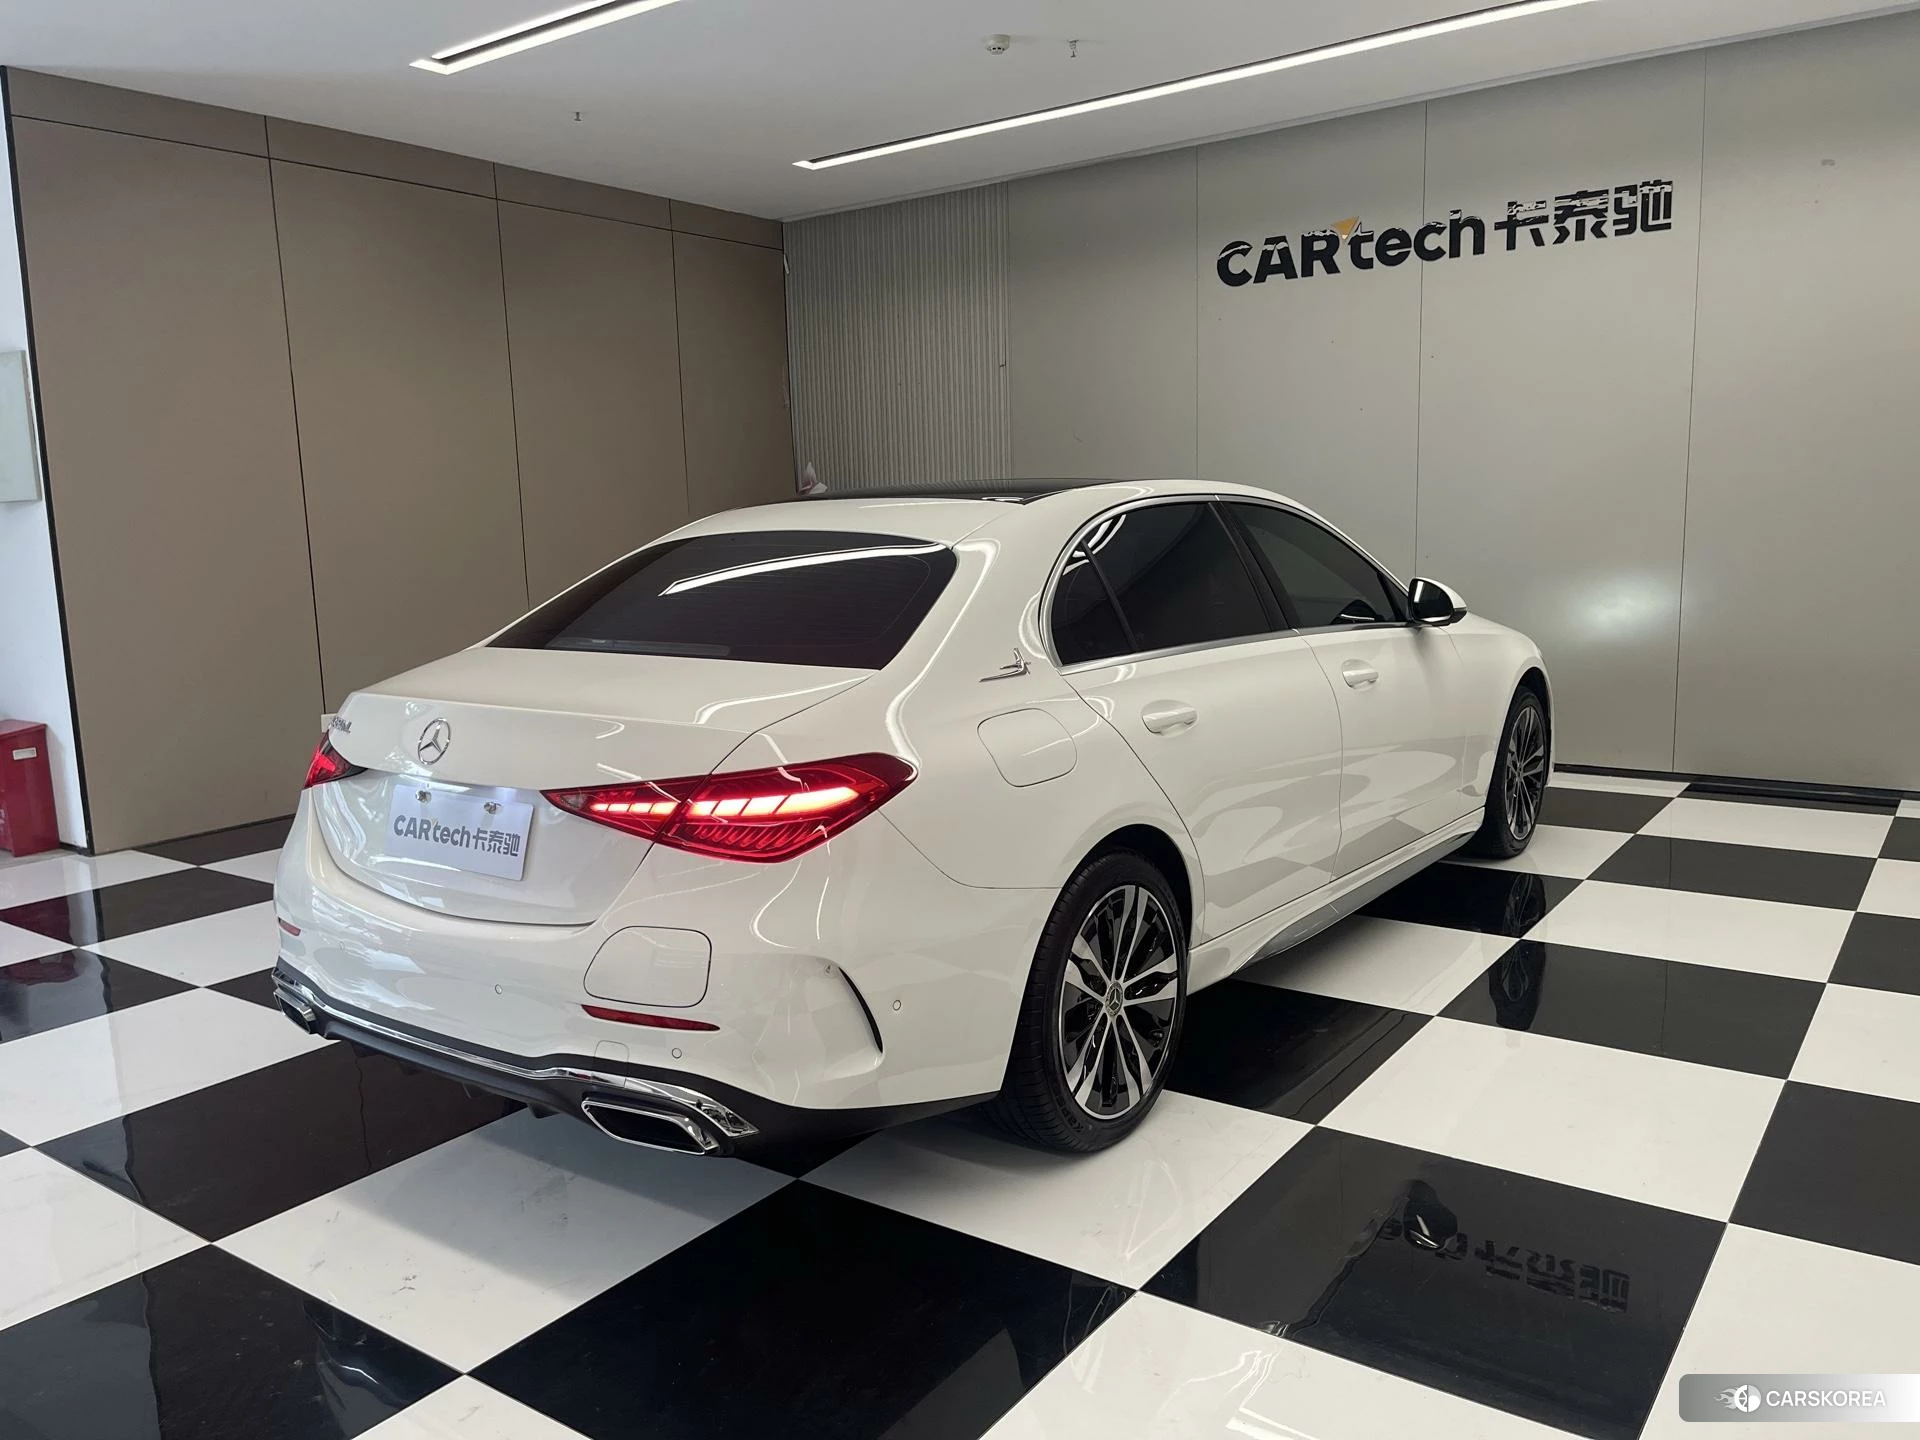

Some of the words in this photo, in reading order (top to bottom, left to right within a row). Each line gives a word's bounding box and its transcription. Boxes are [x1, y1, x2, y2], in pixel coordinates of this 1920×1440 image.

[1216, 209, 1486, 287] CARtech
[1494, 179, 1673, 251] 卡泰驰
[393, 814, 471, 849] CARtech
[472, 827, 521, 857] 卡泰驰
